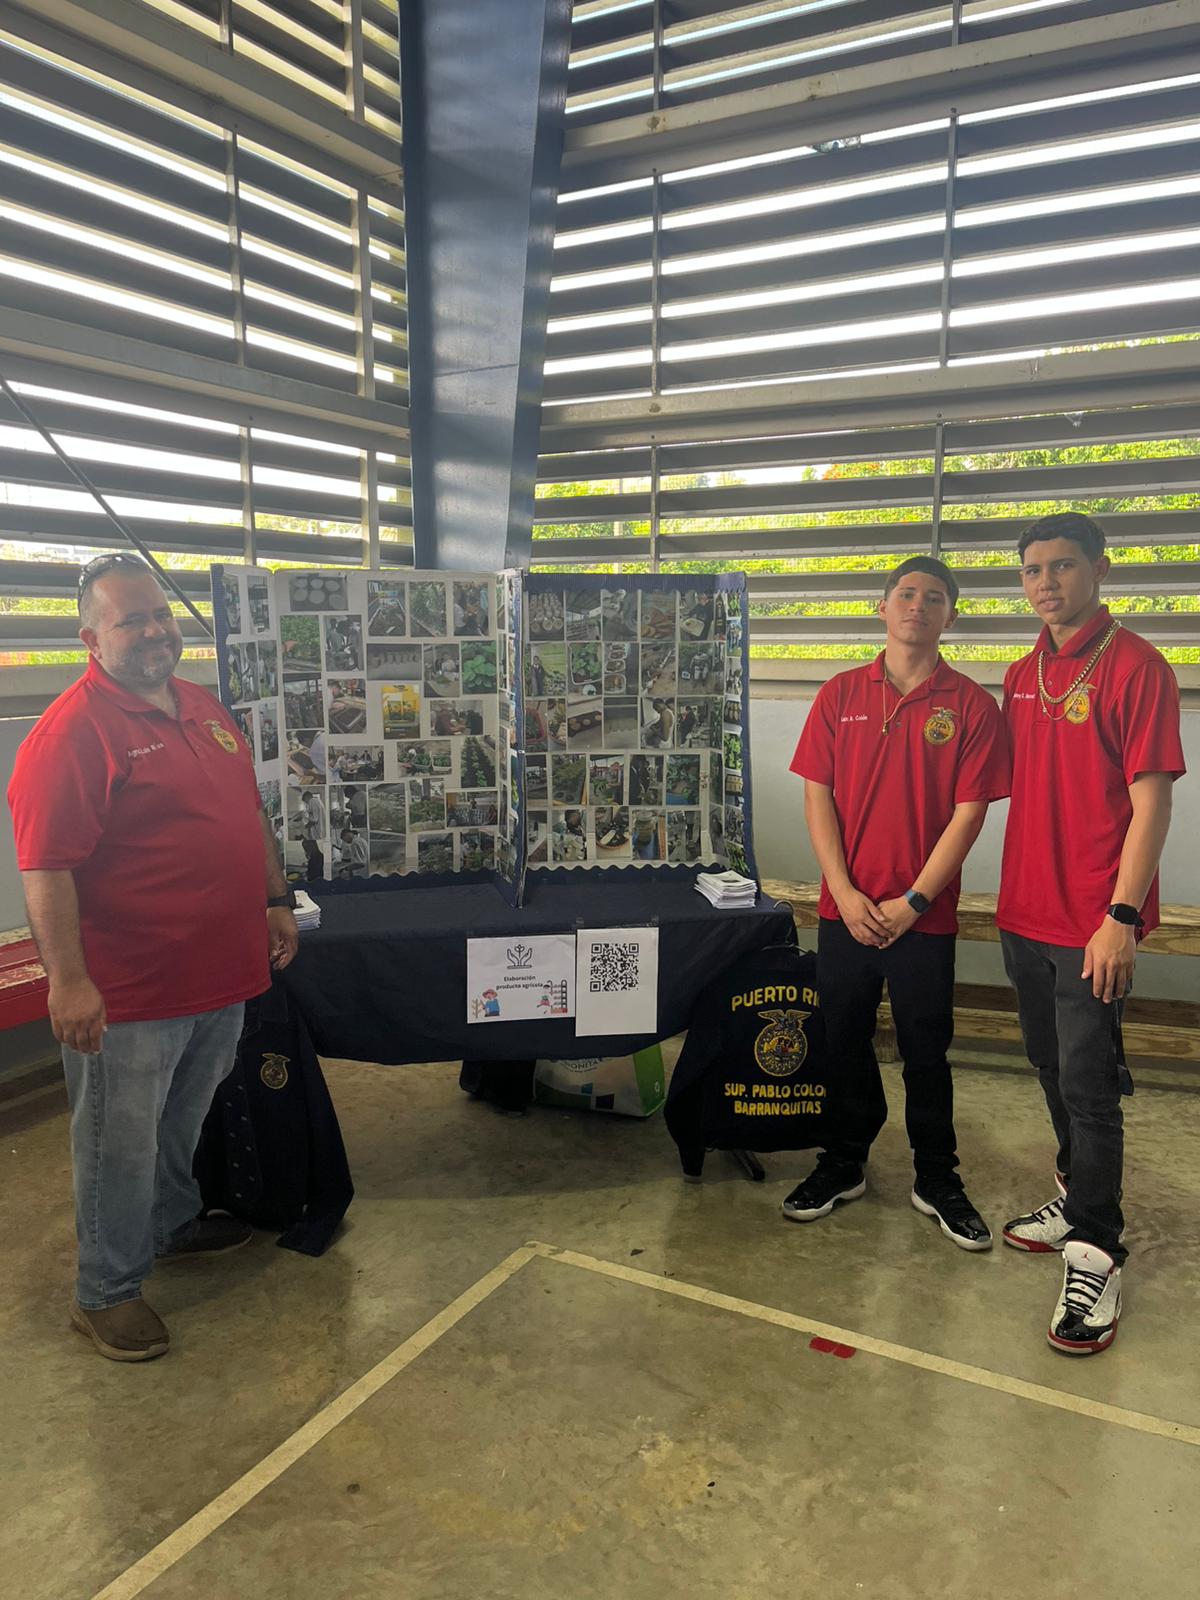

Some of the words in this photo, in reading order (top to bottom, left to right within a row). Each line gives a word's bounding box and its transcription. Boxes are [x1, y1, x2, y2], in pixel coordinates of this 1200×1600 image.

[731, 986, 797, 1011] PUERTO
[802, 988, 820, 1007] RI
[724, 1083, 748, 1097] SUP.
[752, 1084, 791, 1098] PABLO
[793, 1083, 826, 1098] COLO
[734, 1100, 822, 1116] BARRANQUITAS
